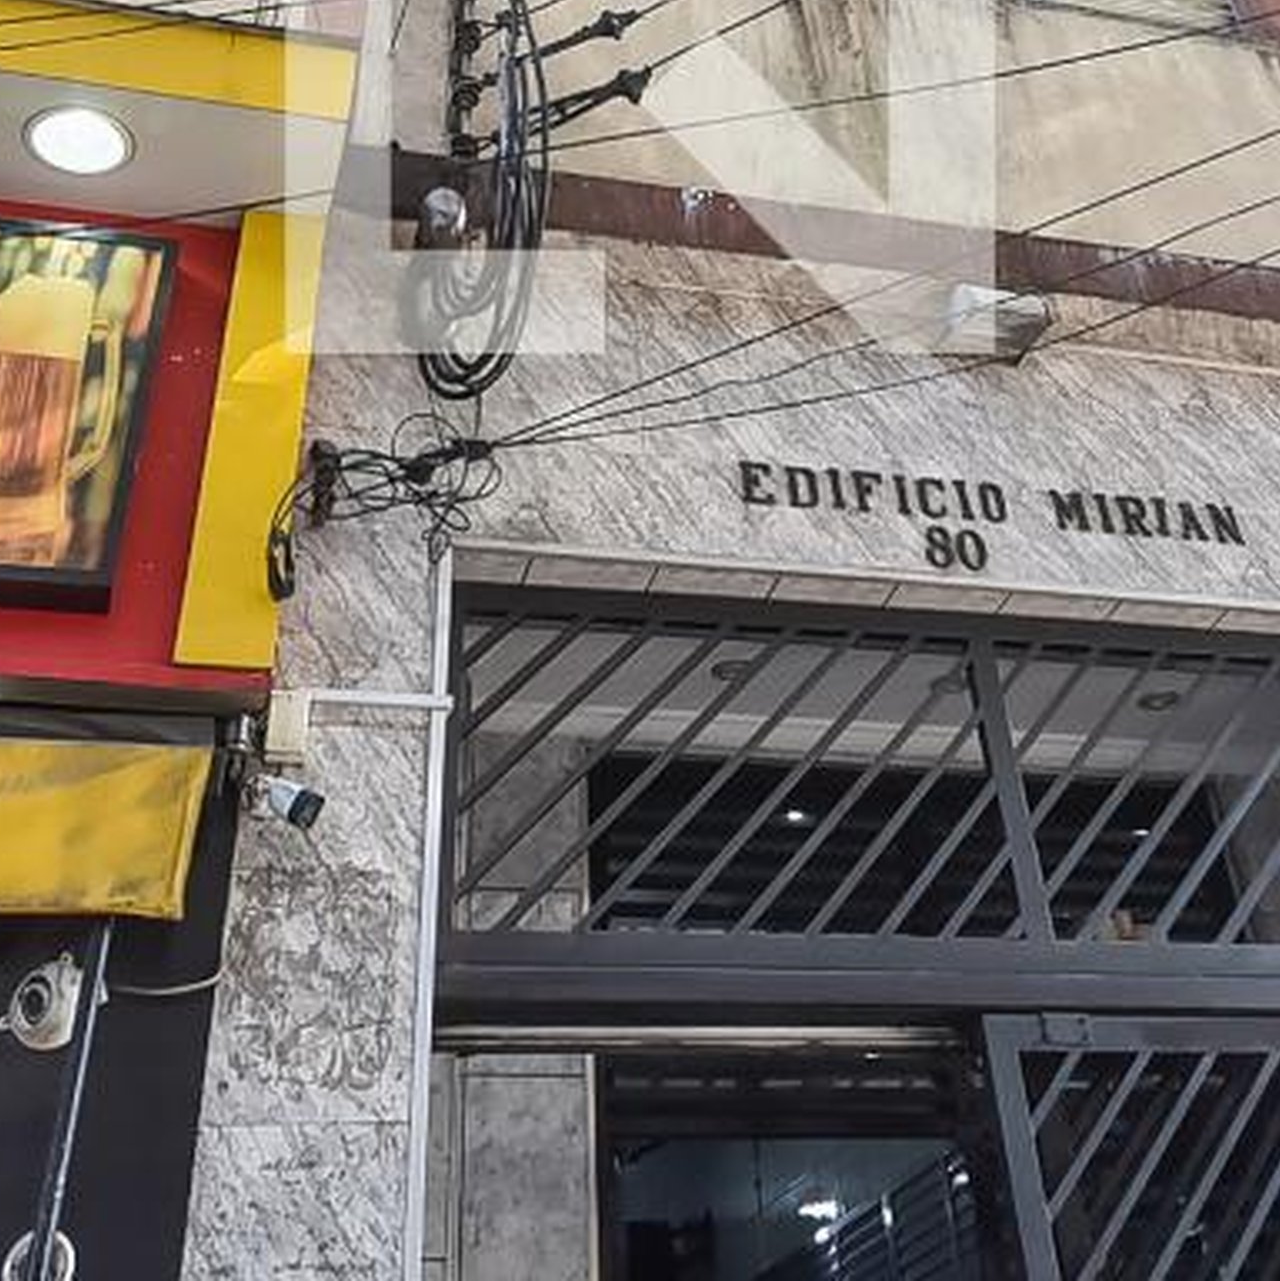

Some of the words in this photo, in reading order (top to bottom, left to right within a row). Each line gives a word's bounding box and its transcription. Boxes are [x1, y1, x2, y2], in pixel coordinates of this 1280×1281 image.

[738, 460, 1008, 523] EDIFICIO
[1047, 489, 1246, 546] MIRIAN
[924, 525, 988, 571] 80
